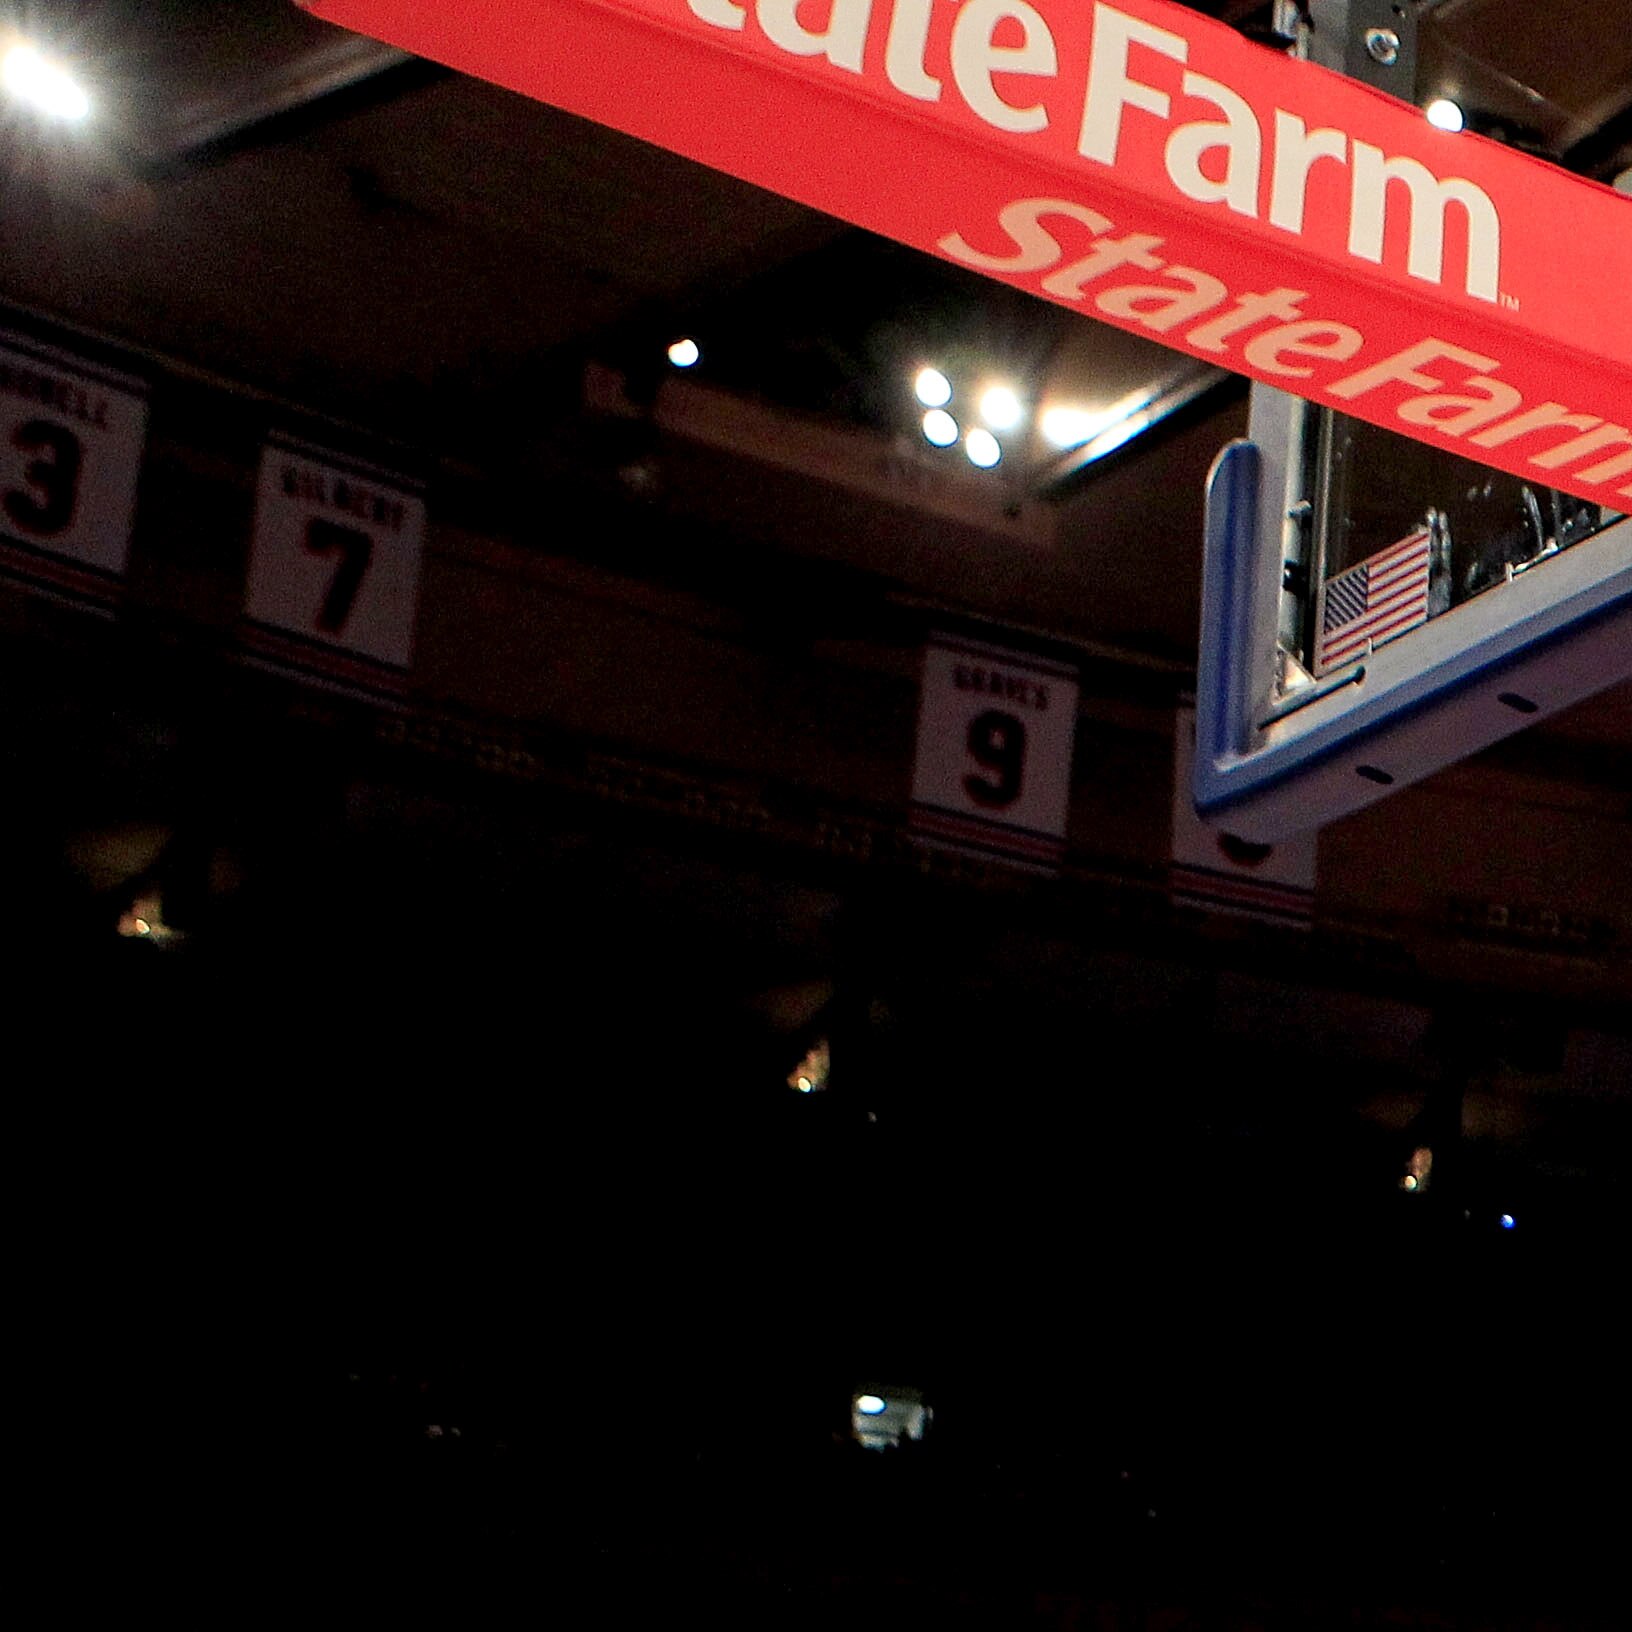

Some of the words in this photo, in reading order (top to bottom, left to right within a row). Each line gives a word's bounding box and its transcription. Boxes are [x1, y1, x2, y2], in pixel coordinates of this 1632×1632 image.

[1077, 0, 1500, 303] Farm
[938, 198, 1364, 379] State
[2, 420, 81, 535] 3
[306, 517, 372, 634] 7
[965, 710, 1026, 809] 9
